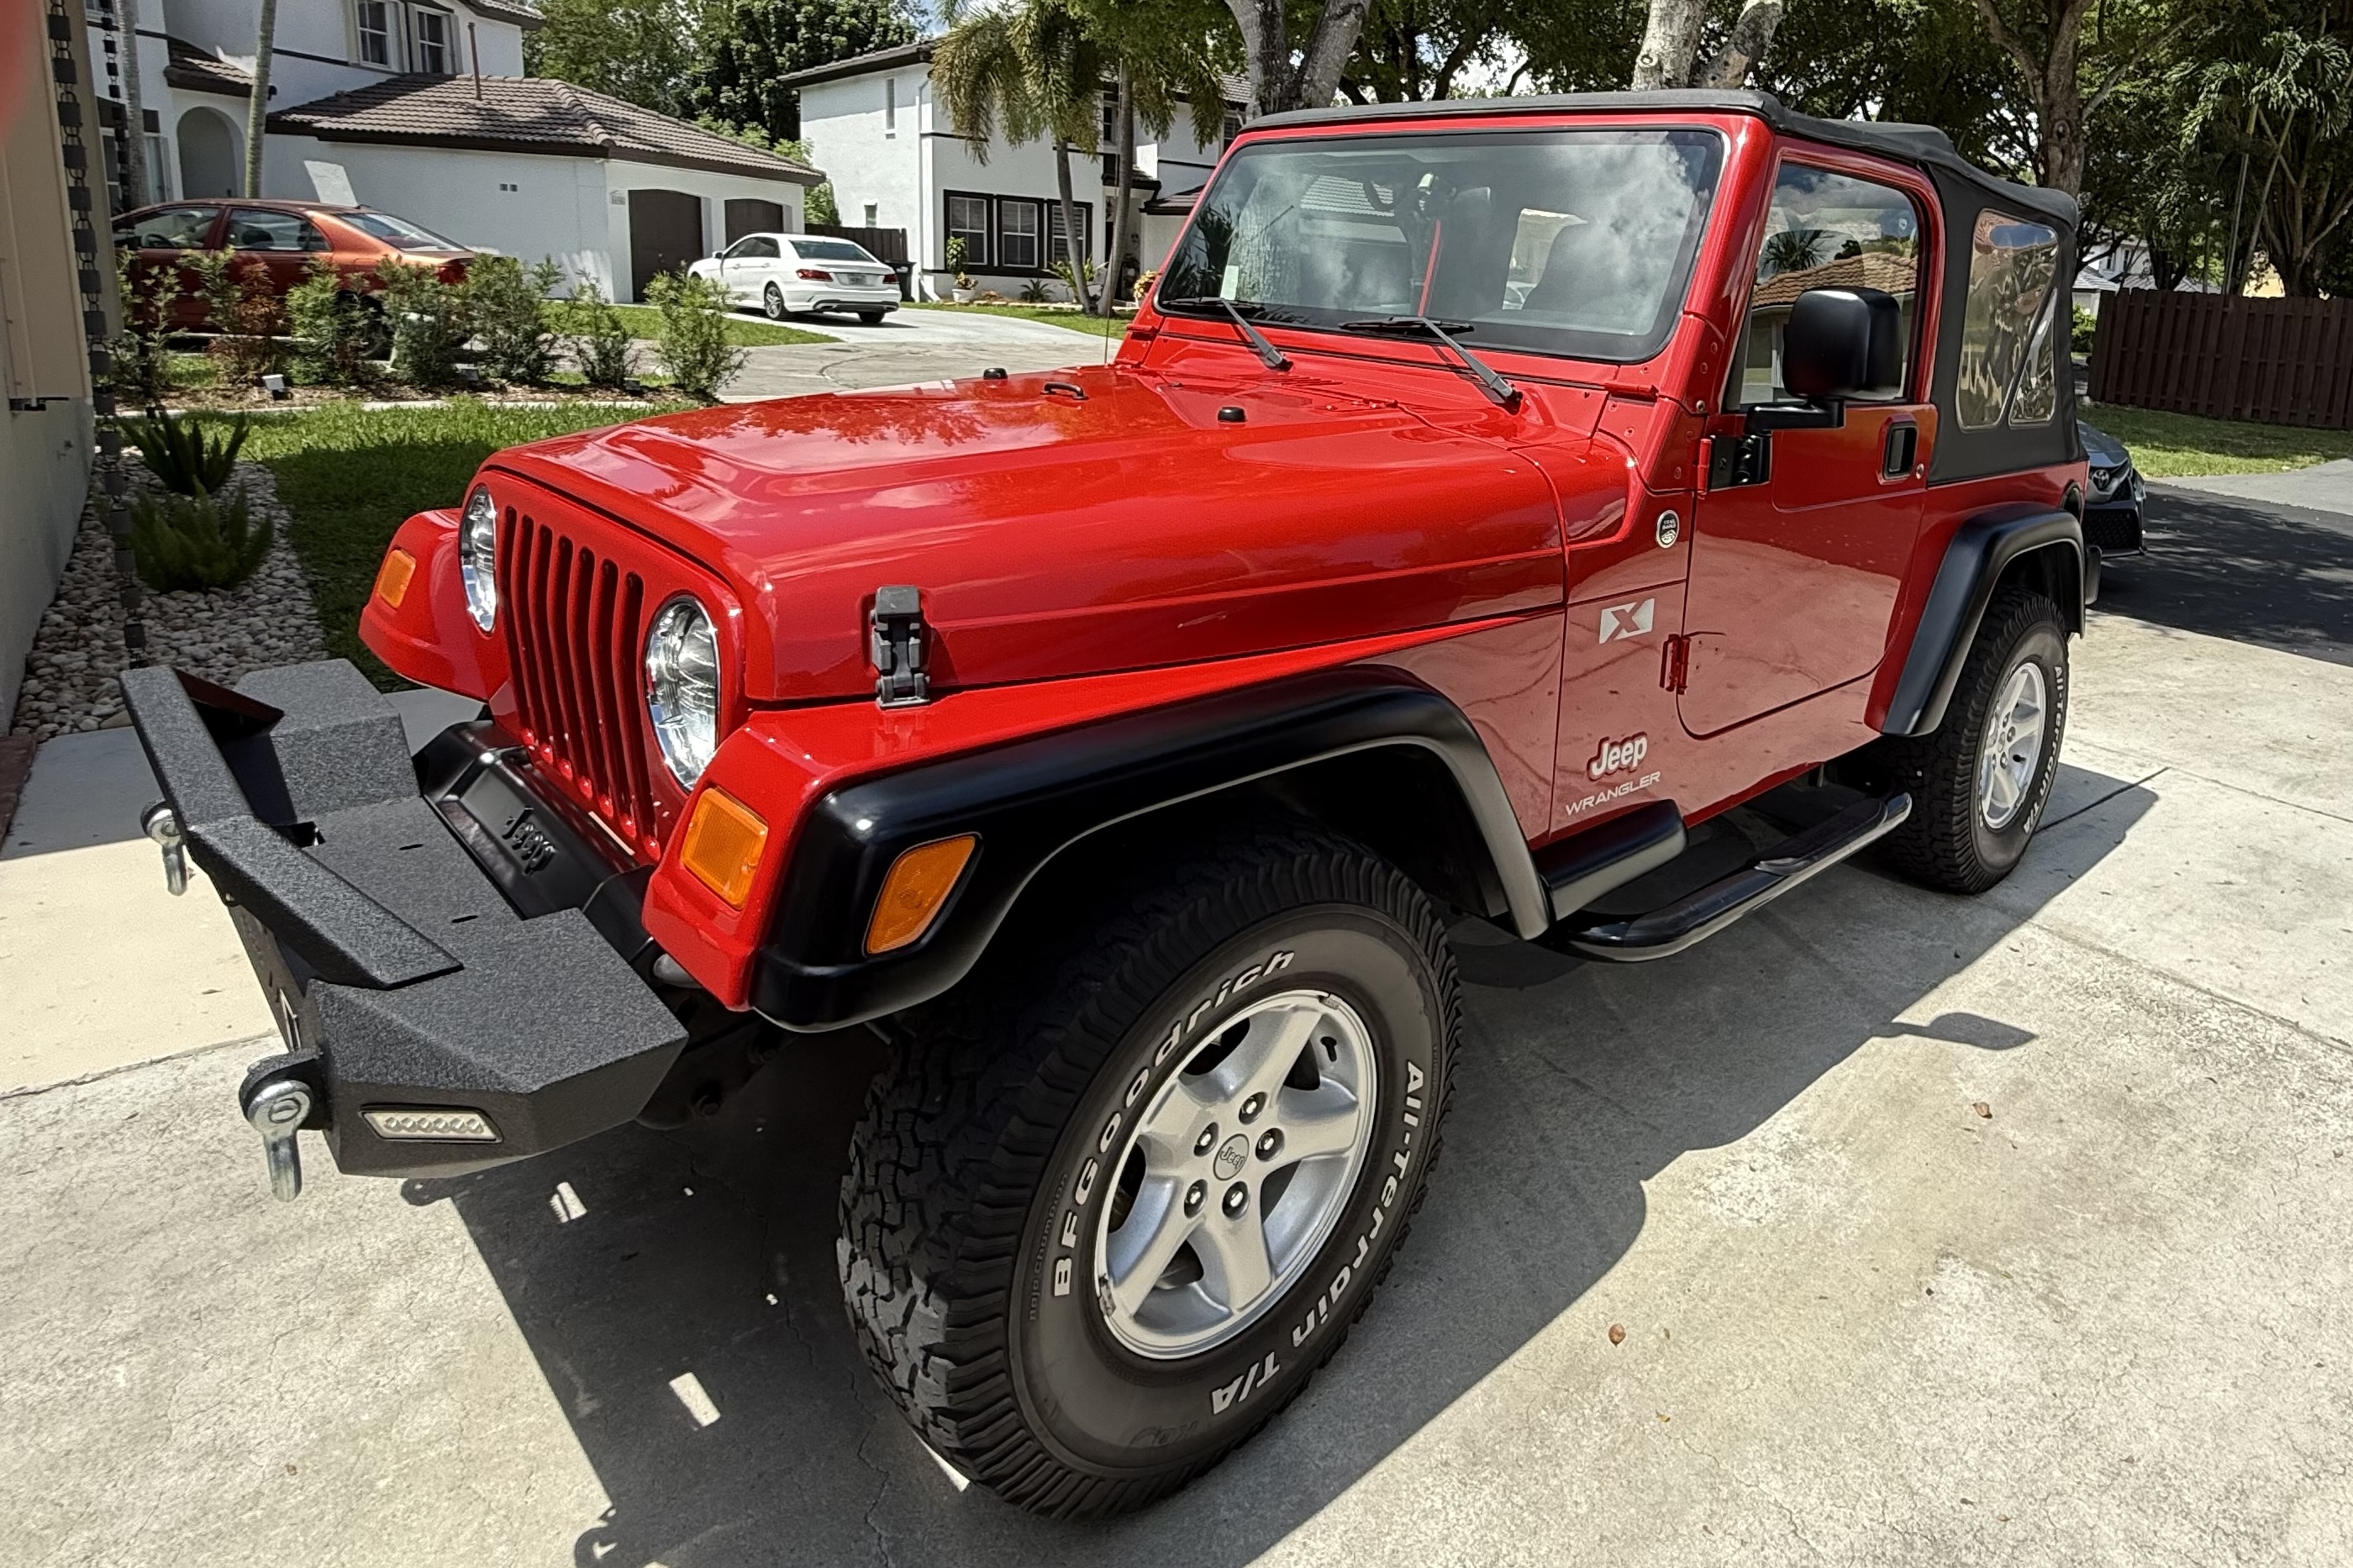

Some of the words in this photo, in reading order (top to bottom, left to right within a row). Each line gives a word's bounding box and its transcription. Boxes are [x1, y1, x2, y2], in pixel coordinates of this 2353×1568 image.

[1601, 598, 1651, 644] X
[2040, 666, 2064, 797] All-Terrain
[1588, 734, 1648, 780] Jeep
[1566, 771, 1661, 816] WRANGLER
[2024, 802, 2040, 834] T/A
[1053, 950, 1295, 1297] BFGoodrich
[1220, 1146, 1246, 1170] Jeep
[1291, 1060, 1424, 1347] All-Terrain
[1211, 1351, 1281, 1415] T/A
